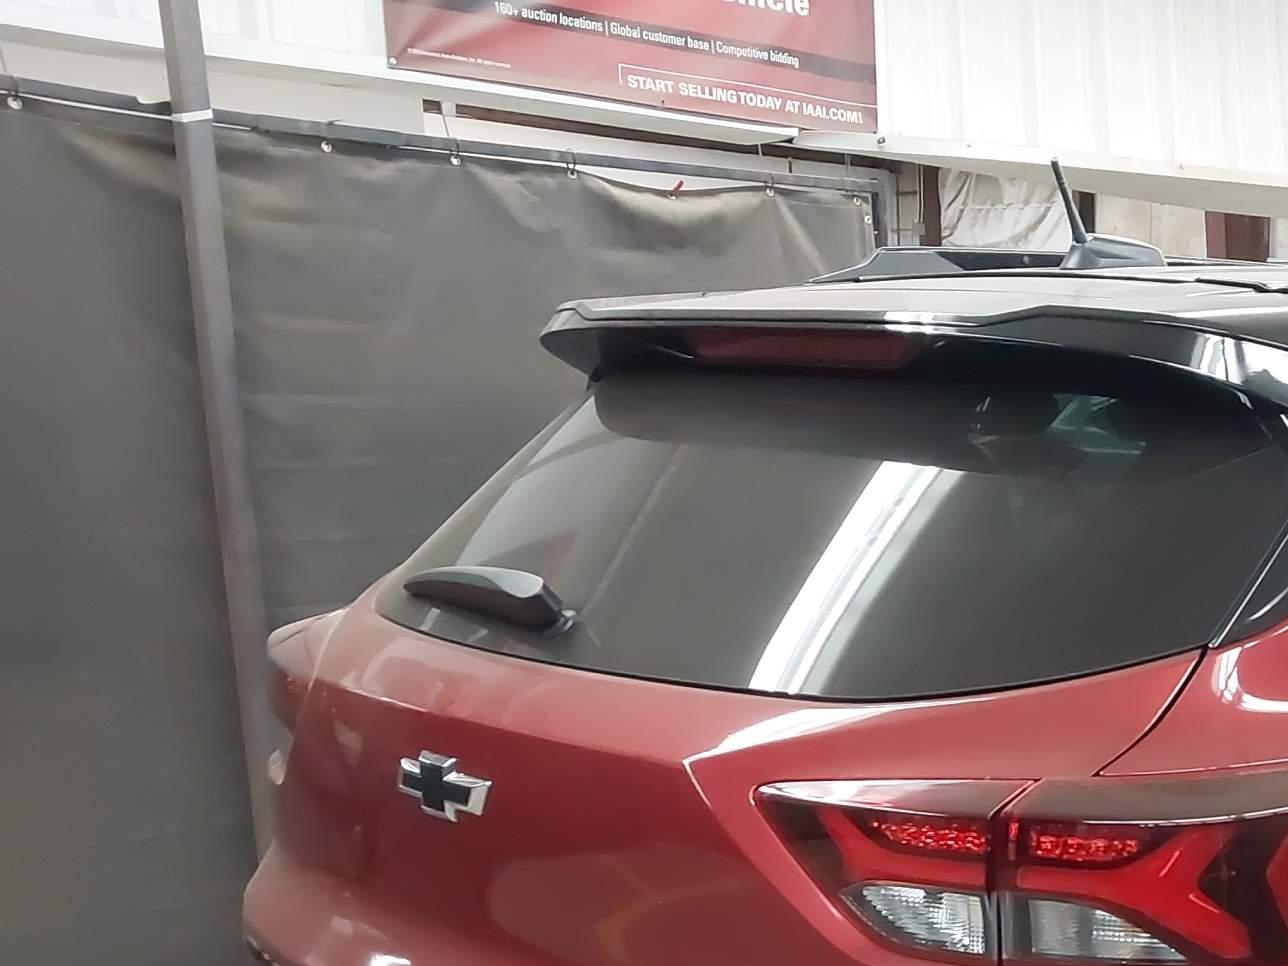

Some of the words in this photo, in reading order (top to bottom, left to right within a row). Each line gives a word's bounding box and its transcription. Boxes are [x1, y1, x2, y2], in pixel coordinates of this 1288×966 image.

[521, 7, 558, 24] auction
[559, 13, 603, 32] locations
[610, 22, 641, 39] Global
[643, 30, 686, 46] customer
[687, 36, 710, 51] base
[716, 41, 769, 61] Competitive
[770, 50, 800, 69] bidding
[627, 75, 675, 94] START
[679, 83, 738, 104] SELLING
[738, 91, 783, 111] TODAY
[784, 101, 800, 114] AT
[802, 103, 864, 125] IAAI.COM!
